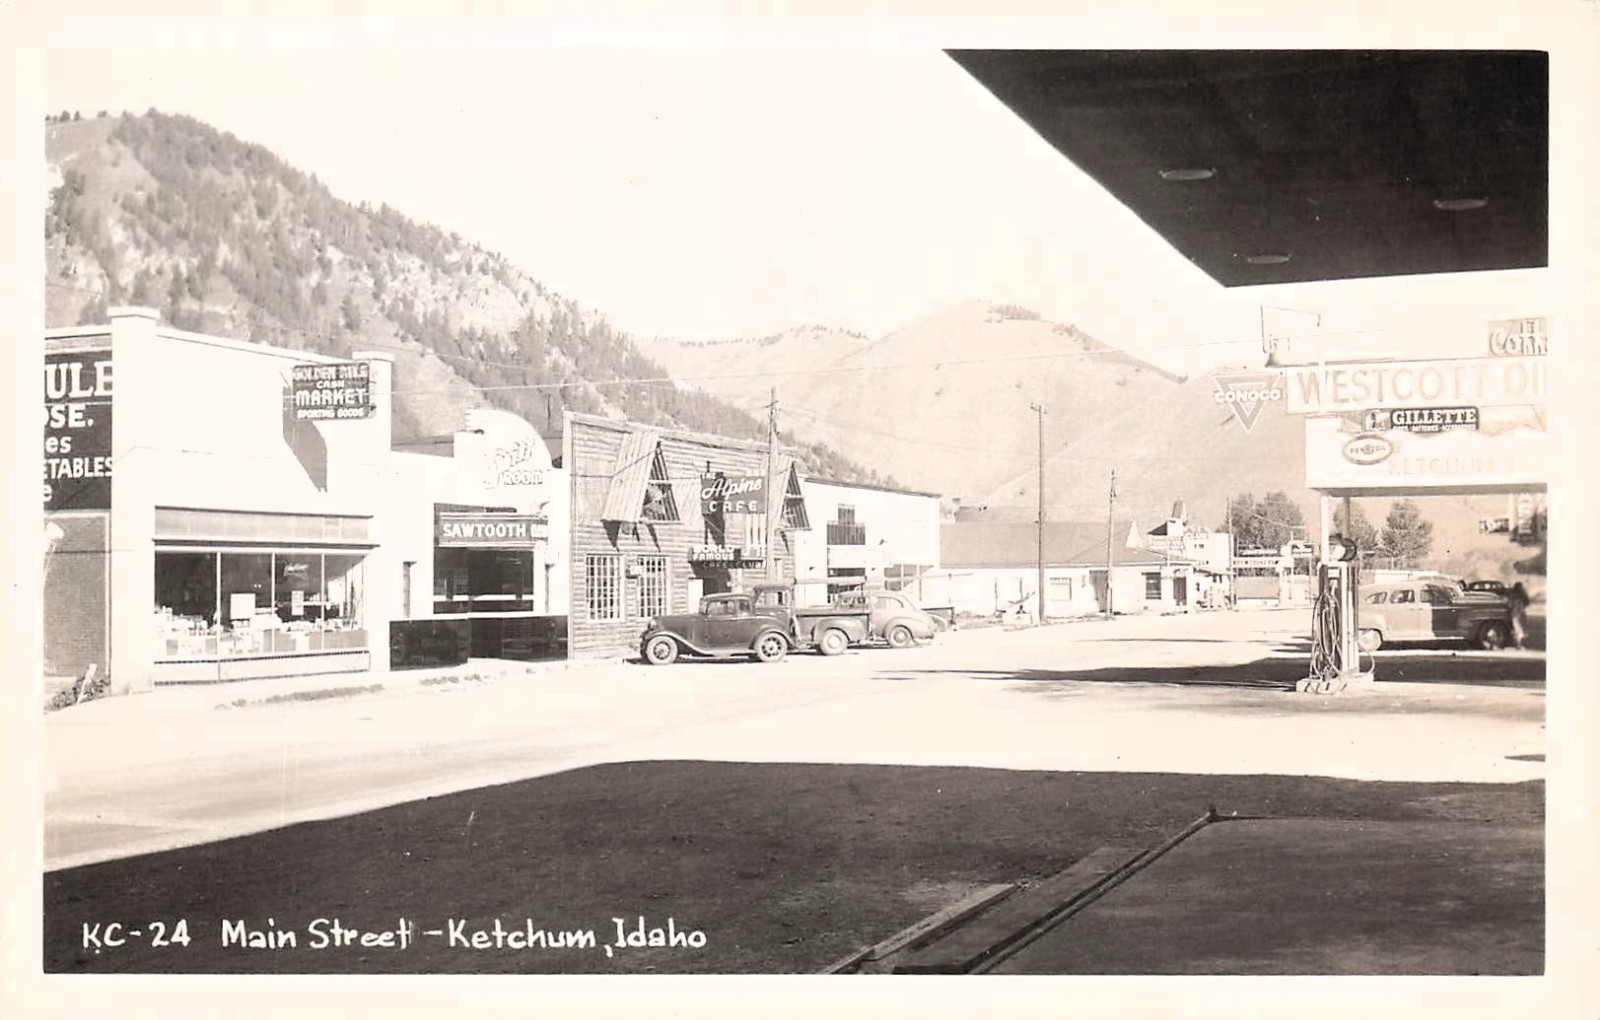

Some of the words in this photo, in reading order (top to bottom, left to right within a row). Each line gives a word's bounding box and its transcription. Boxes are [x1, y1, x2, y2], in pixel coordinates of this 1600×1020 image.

[316, 380, 345, 389] CASH
[1296, 364, 1488, 405] WESTCOTT
[296, 388, 367, 406] MARKET
[1213, 388, 1282, 404] CONOCO
[297, 409, 335, 419] SPORTING
[337, 408, 364, 418] GOODS
[1392, 408, 1477, 425] GILLETTE
[45, 436, 72, 454] es
[503, 471, 542, 485] ROOM
[701, 478, 763, 500] Alpine
[709, 501, 758, 512] CAFE
[443, 523, 527, 538] SAWTOOTH
[693, 545, 735, 554] WORLD
[693, 553, 735, 561] FAMOUS
